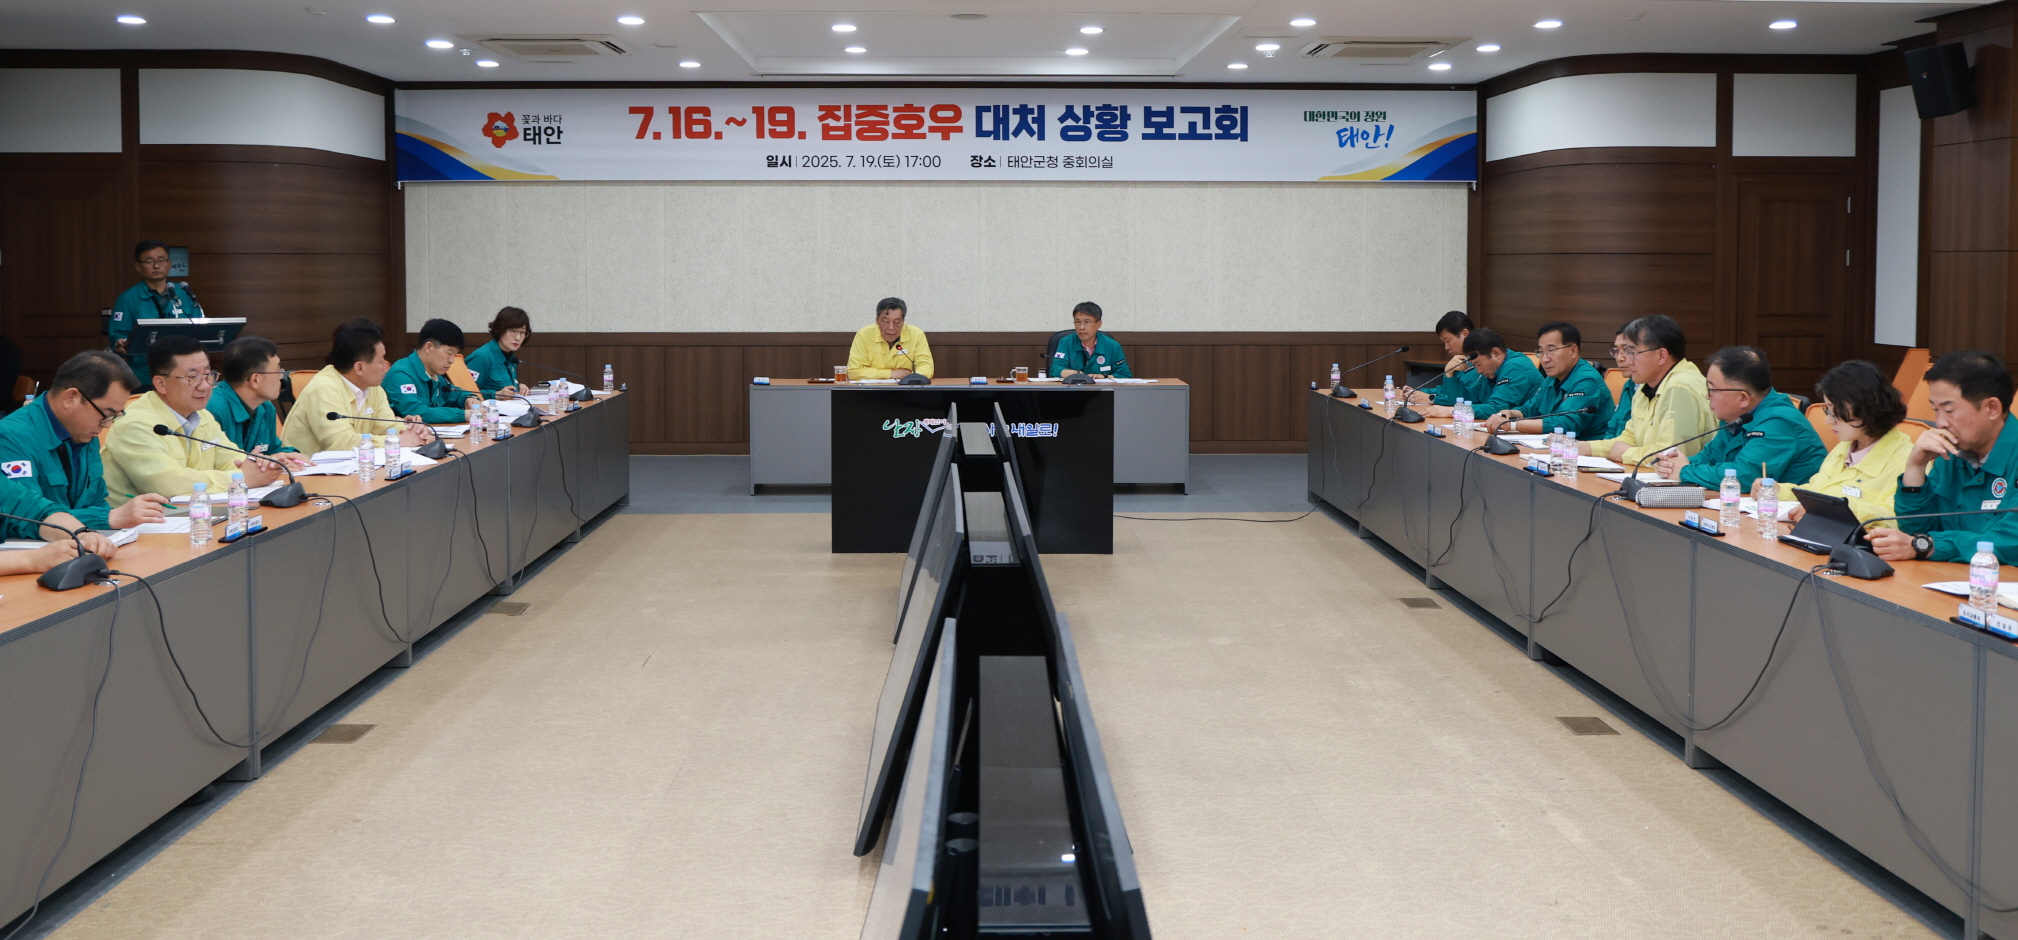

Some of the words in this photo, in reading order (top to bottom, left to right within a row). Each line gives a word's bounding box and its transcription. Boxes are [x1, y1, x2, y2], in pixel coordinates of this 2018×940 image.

[522, 114, 541, 125] 꽃과
[543, 114, 563, 125] 바다
[816, 103, 964, 142] 집중호우
[975, 103, 1046, 141] 대처
[1057, 103, 1131, 142] 상황
[1141, 104, 1249, 142] 보고회
[1303, 110, 1361, 122] 대한민국의
[1363, 110, 1387, 122] 정원
[523, 125, 564, 145] 태안
[1335, 124, 1395, 149] 태안!
[766, 155, 792, 168] 일시
[801, 155, 842, 168] 2025.
[845, 155, 856, 168] 7.
[860, 154, 901, 169] 19.(토)
[905, 155, 942, 168] 17:00
[970, 155, 997, 168] 장소
[1007, 155, 1059, 169] 태안군청
[1062, 155, 1114, 169] 중회의실
[1011, 422, 1059, 438] 내일로!
